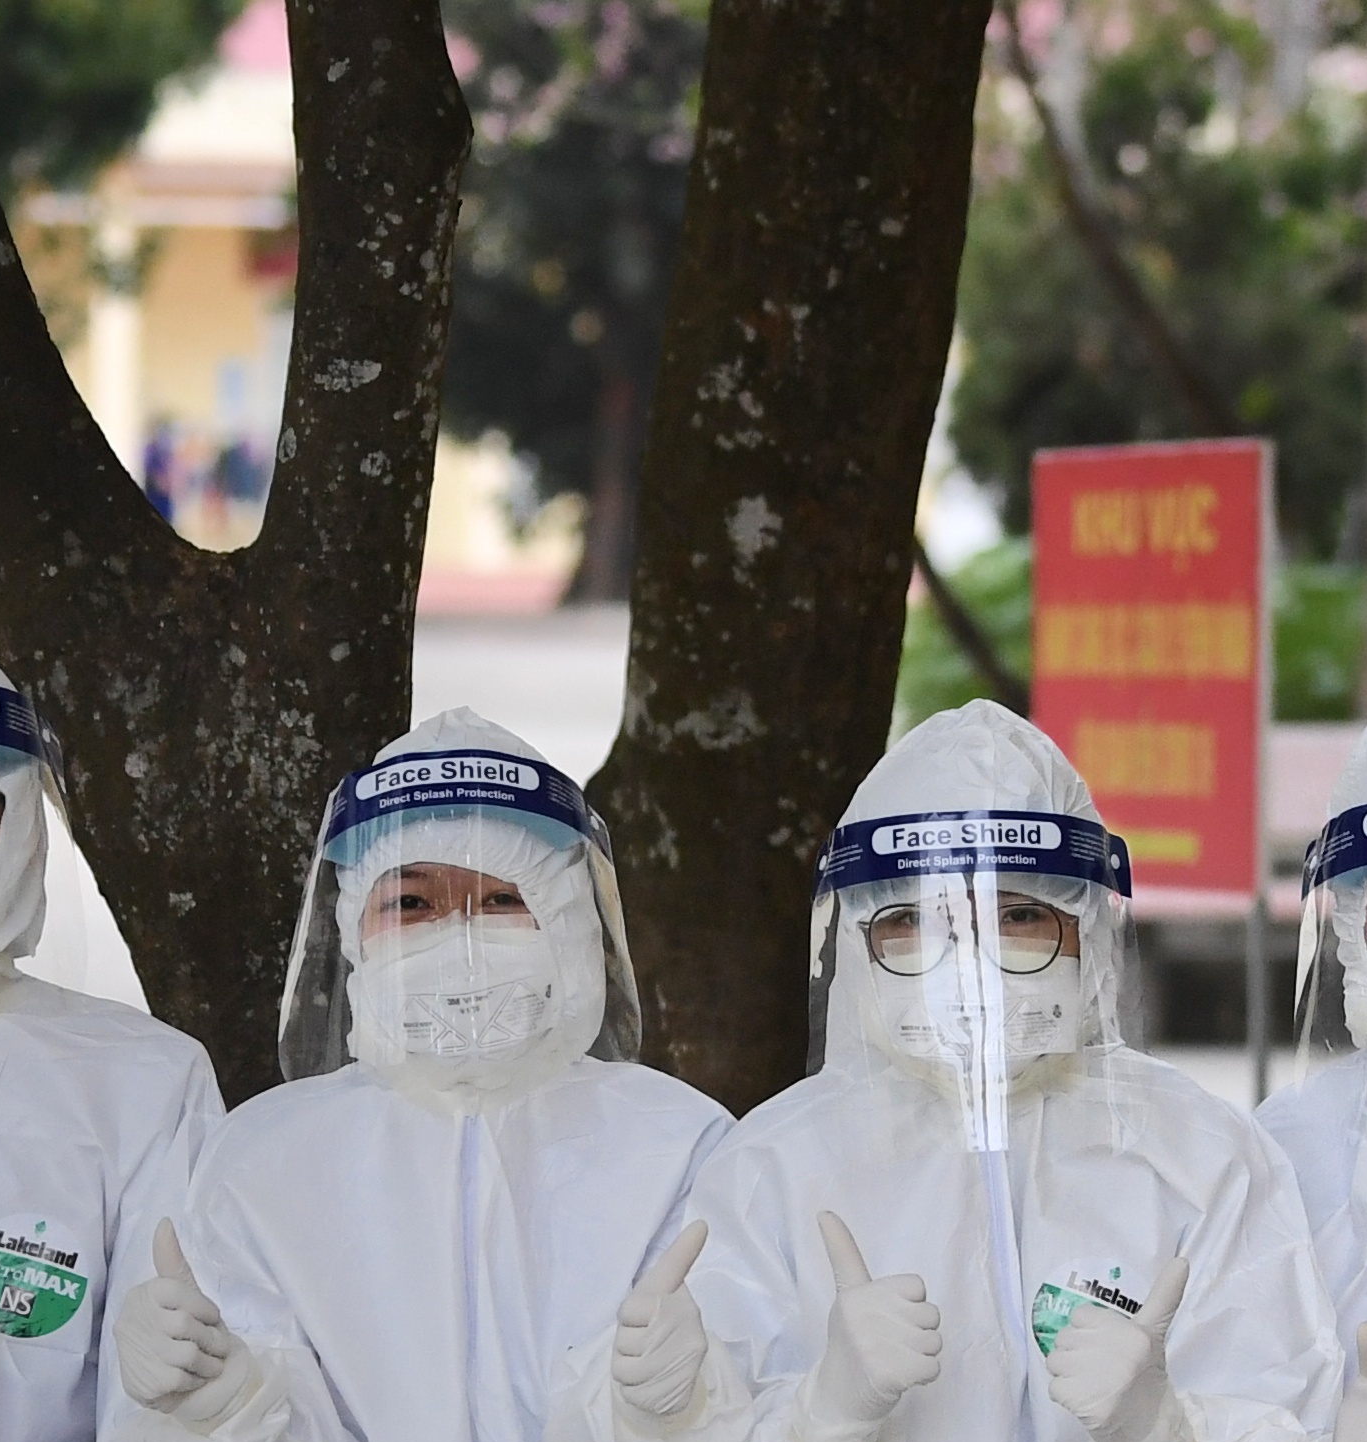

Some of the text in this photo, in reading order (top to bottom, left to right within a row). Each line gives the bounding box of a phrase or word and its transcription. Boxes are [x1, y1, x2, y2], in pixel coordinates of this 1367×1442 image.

[374, 760, 520, 792] Face Shield
[379, 787, 516, 809] Direct Splash Protection
[892, 823, 1042, 849] Face Shield
[897, 853, 1037, 870] Direct Splash Protection
